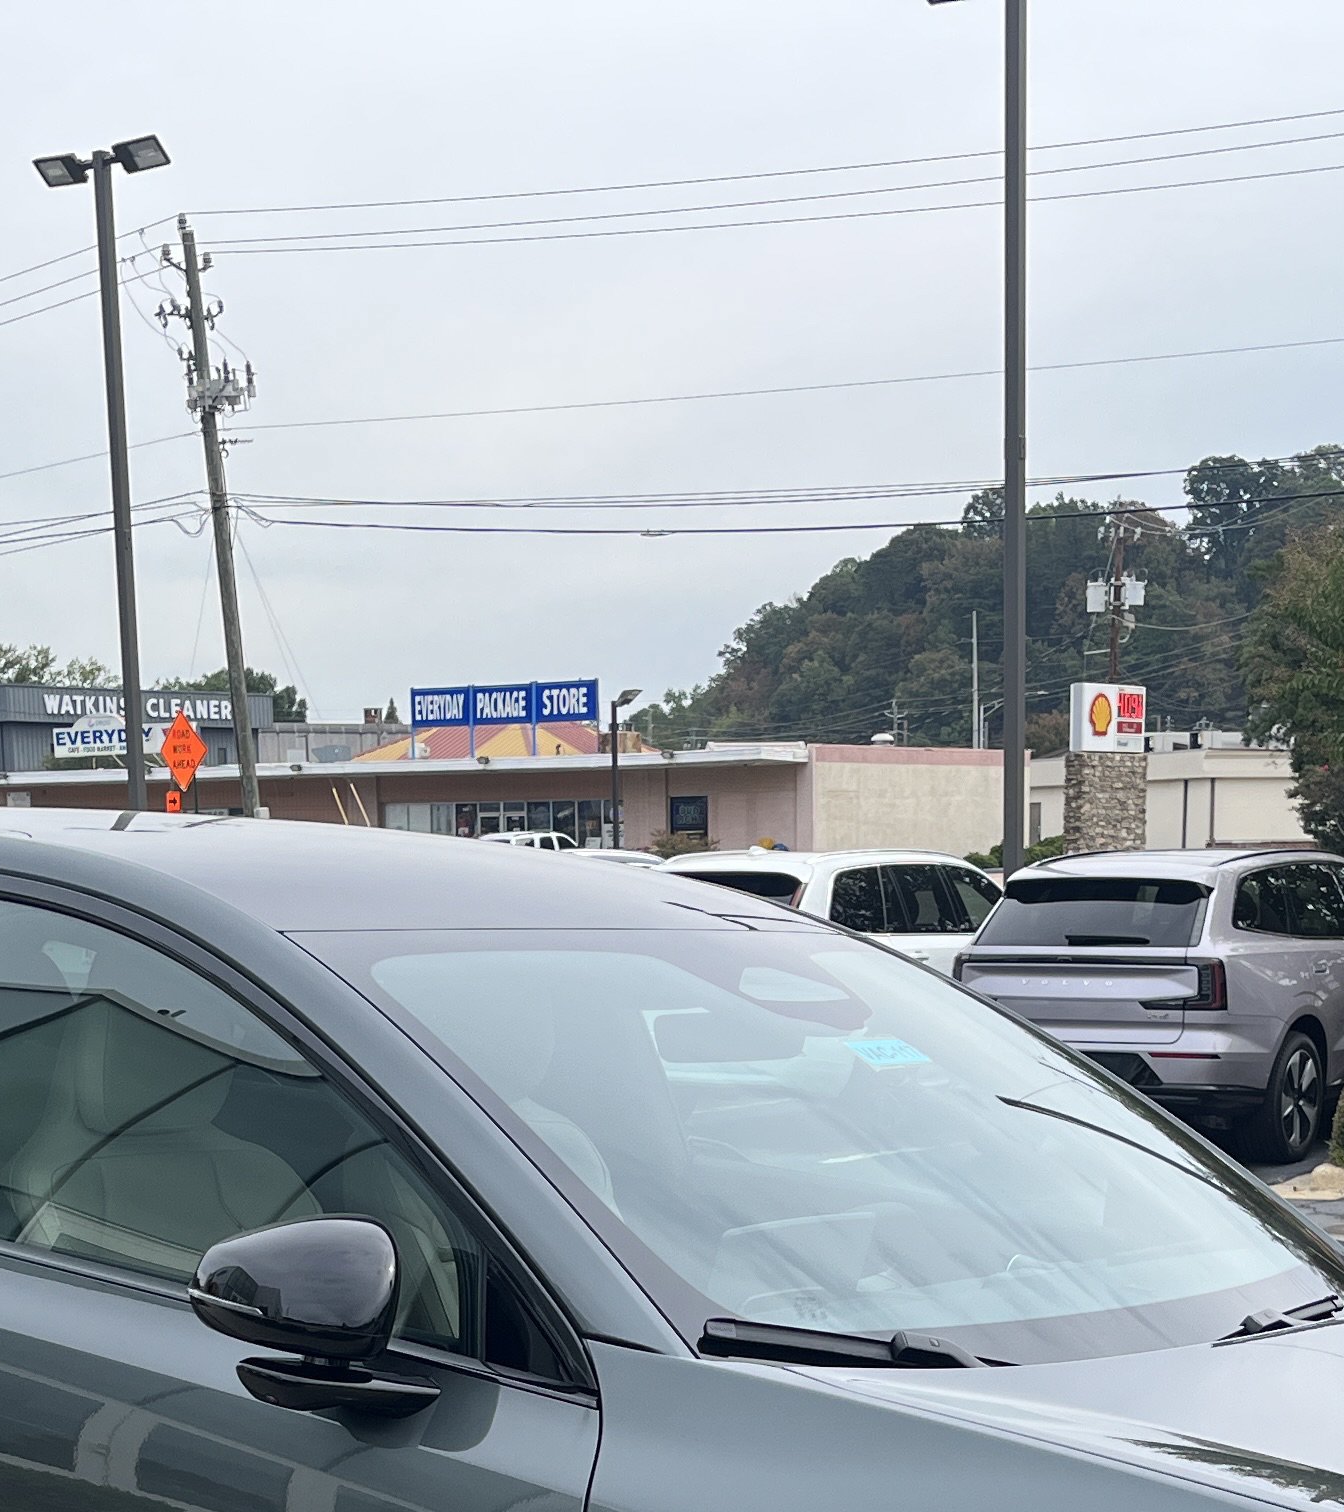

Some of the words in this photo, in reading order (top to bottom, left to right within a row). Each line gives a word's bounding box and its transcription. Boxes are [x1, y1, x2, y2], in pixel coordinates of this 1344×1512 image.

[146, 697, 233, 720] CLEANER
[415, 693, 465, 721] EVERYDAY
[476, 690, 526, 719] PACKAGE
[542, 687, 588, 716] STORE
[55, 727, 153, 746] EVERYDY
[173, 759, 196, 769] AHEAD
[1021, 978, 1113, 987] VOLVO
